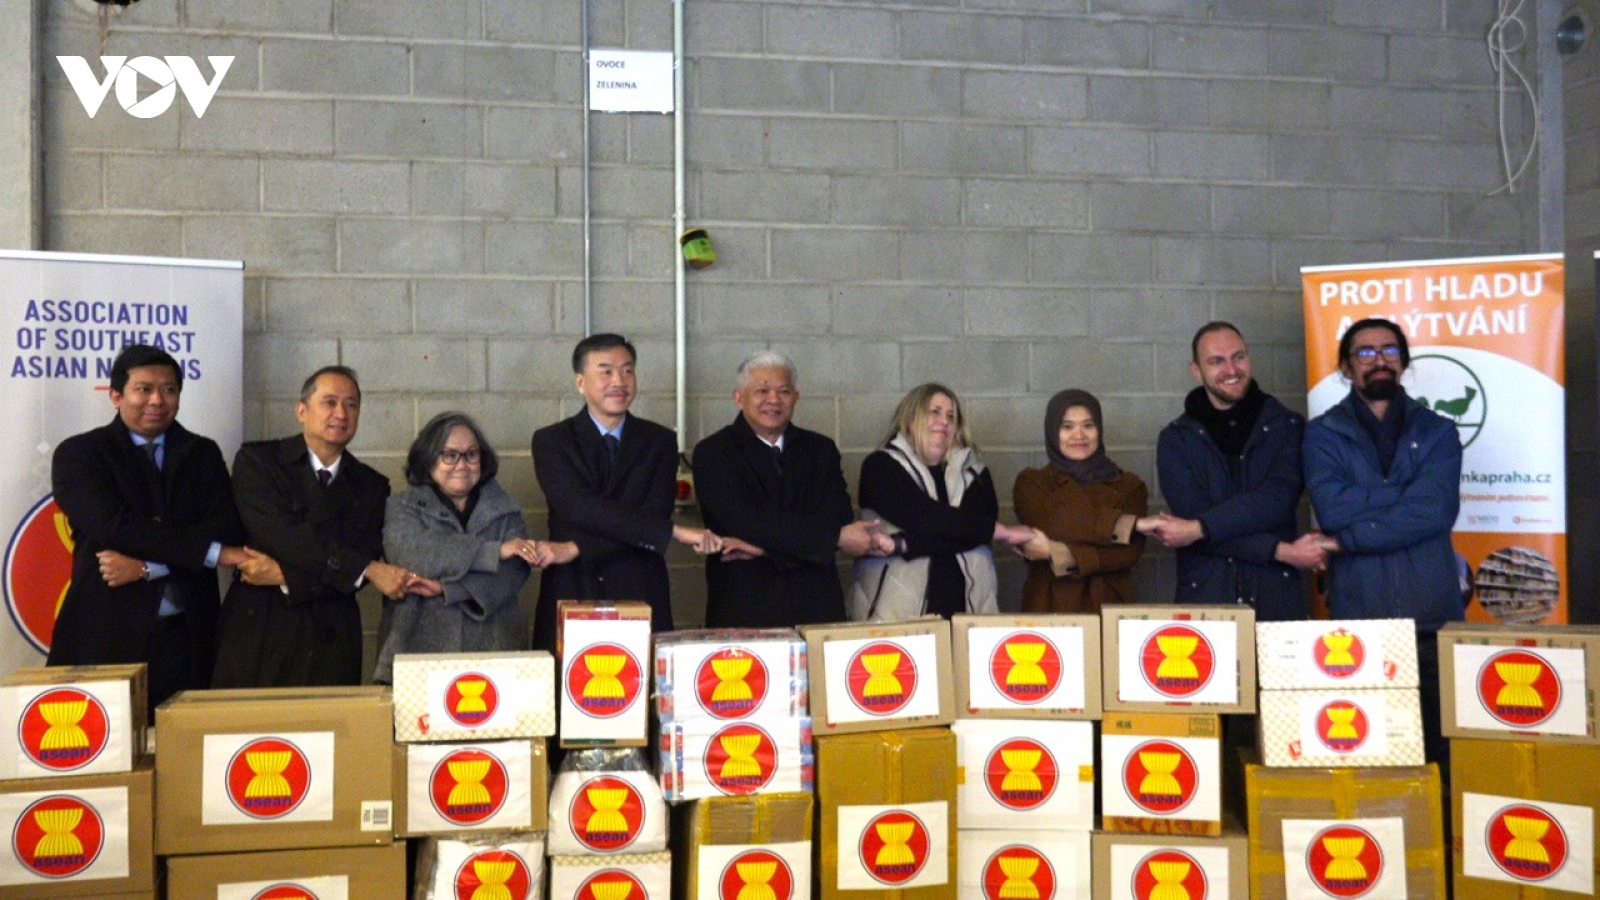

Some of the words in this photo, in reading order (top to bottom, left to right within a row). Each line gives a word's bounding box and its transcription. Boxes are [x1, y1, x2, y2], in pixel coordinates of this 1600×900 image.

[596, 60, 625, 69] OVOCE
[596, 81, 637, 90] ZELENINA
[1320, 278, 1412, 307] PROTI
[1425, 271, 1544, 302] HLADU
[24, 299, 189, 326] ASSOCIATION
[1368, 304, 1529, 338] ÝTVÁNÍ
[16, 327, 47, 350] OF
[54, 328, 196, 353] SOUTHEAST
[11, 355, 87, 379] ASIAN
[1461, 470, 1552, 486] nkapraha.cz
[1006, 684, 1048, 694] asean
[863, 694, 904, 706] asean
[40, 747, 92, 761] asean
[1001, 790, 1044, 801] asean
[1139, 793, 1184, 805] asean
[447, 802, 492, 816] asean
[585, 832, 630, 842] asean
[33, 854, 86, 868] asean
[875, 863, 916, 875] asean
